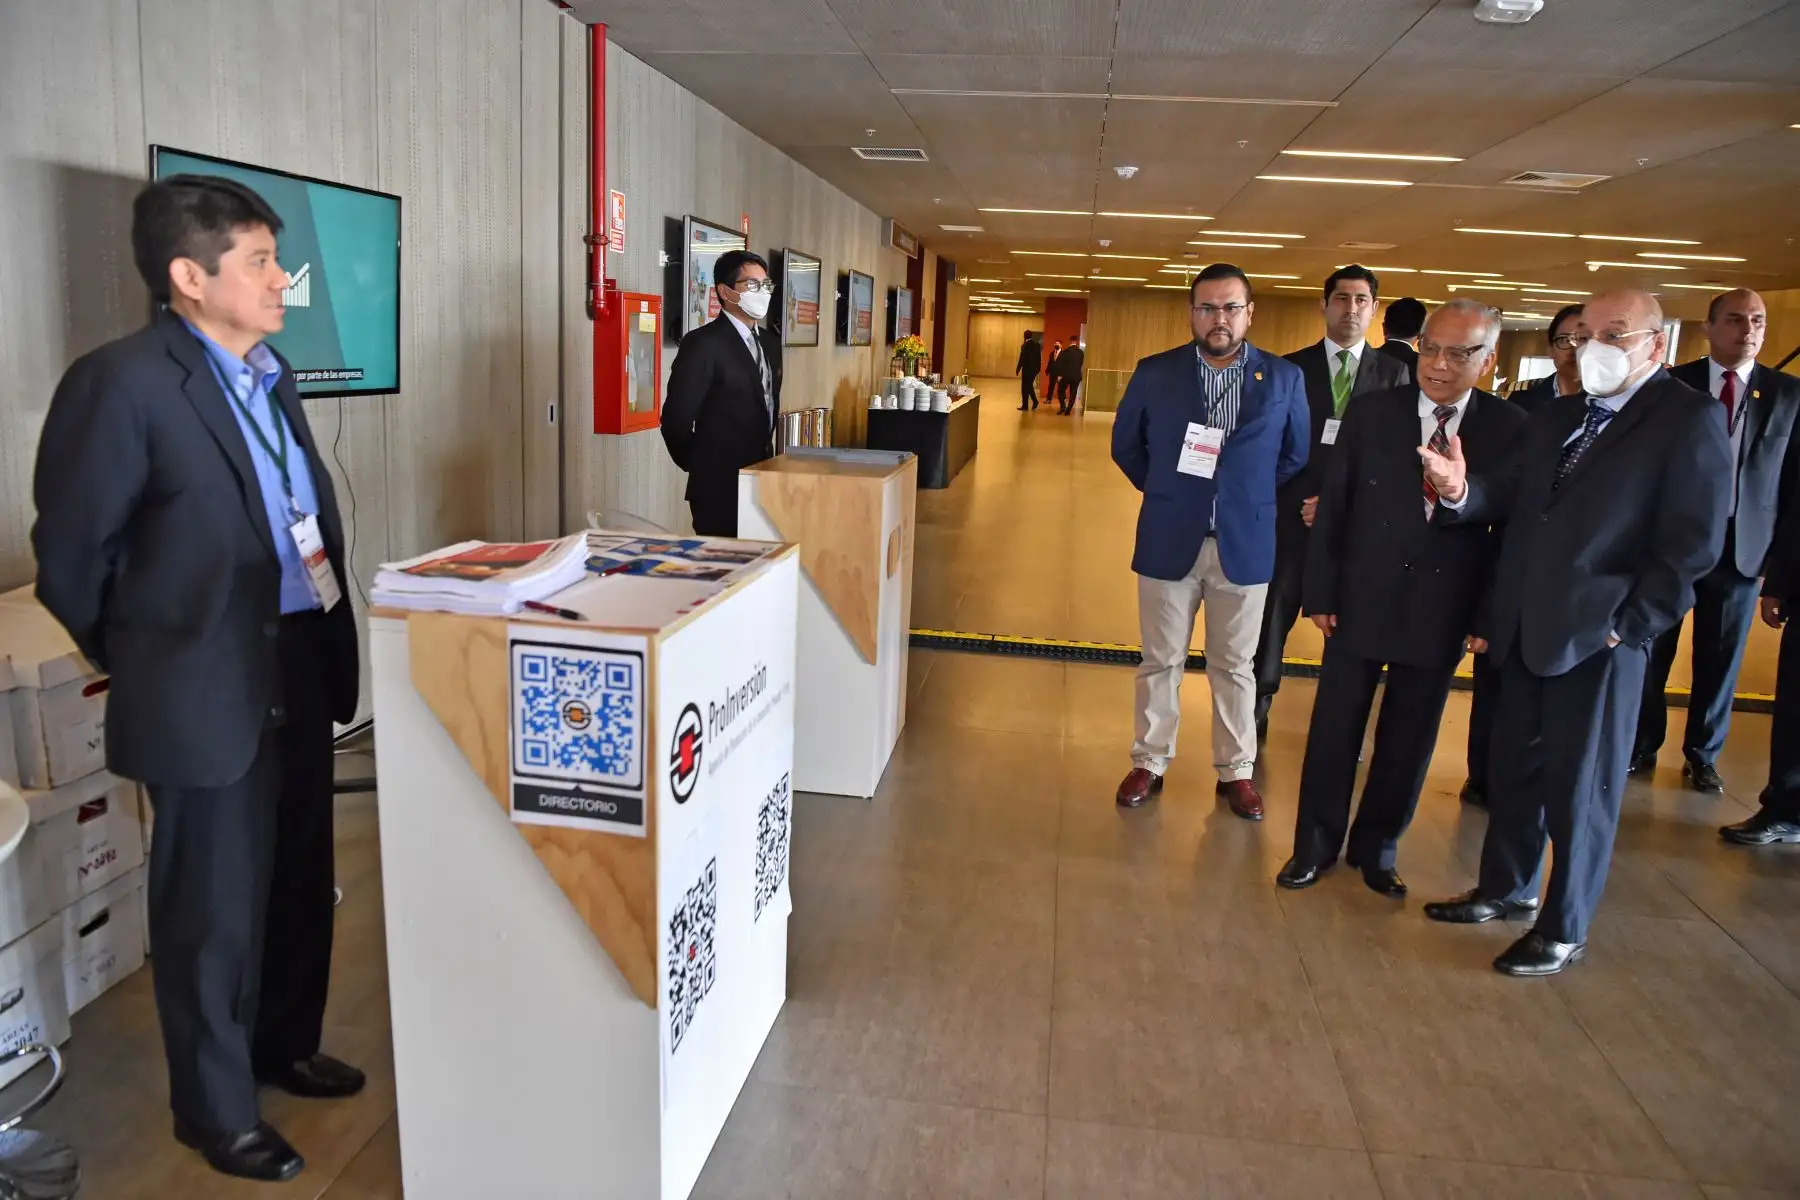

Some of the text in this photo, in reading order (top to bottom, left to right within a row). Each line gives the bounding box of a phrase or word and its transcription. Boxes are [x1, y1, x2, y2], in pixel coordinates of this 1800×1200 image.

[322, 370, 329, 379] de
[329, 370, 338, 379] las
[539, 793, 617, 814] DIRECTORIO
